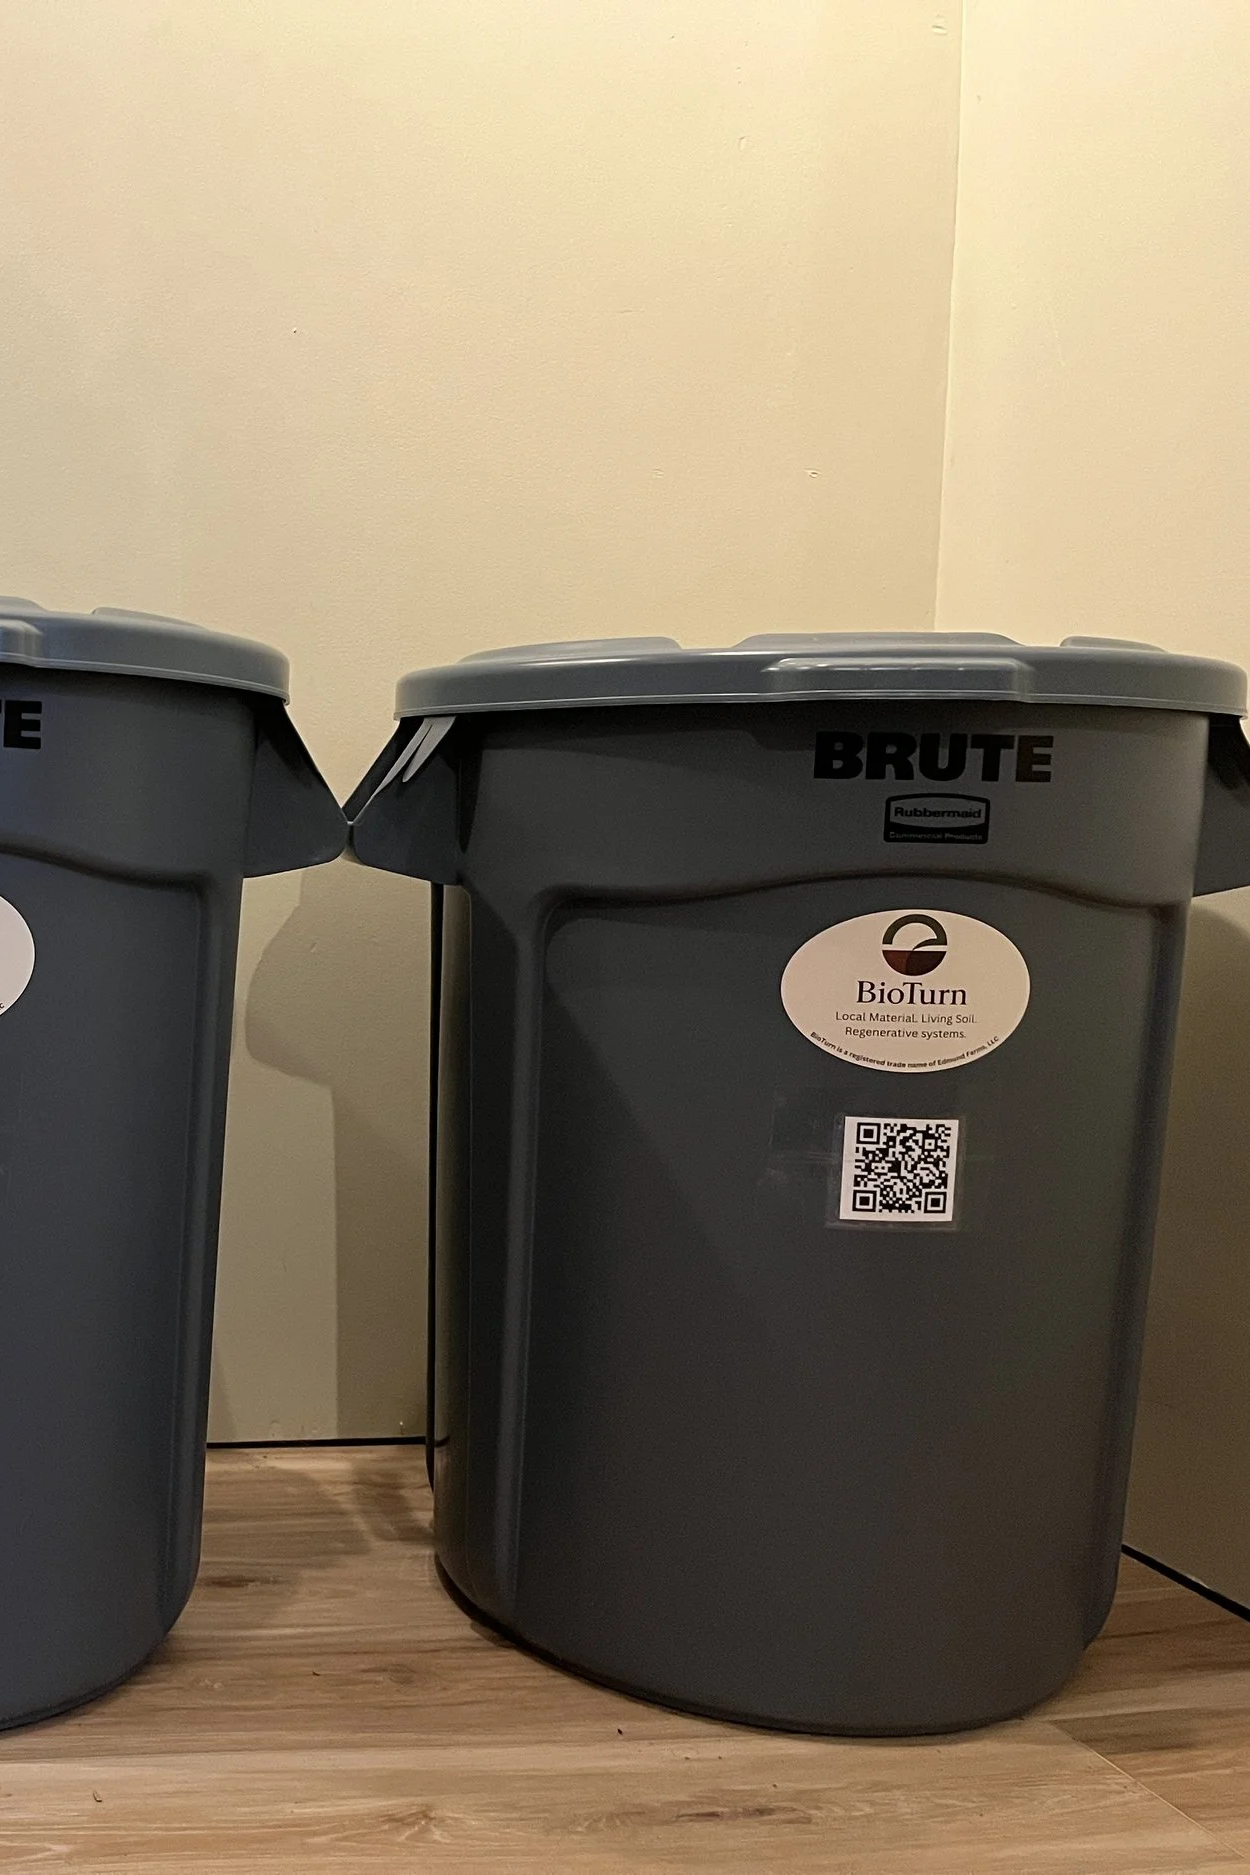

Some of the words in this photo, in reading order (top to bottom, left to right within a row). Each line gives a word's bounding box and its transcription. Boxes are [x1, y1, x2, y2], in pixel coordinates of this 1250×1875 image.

[814, 731, 1054, 782] BRUTE
[894, 807, 982, 818] Rubbermaid
[857, 980, 967, 1006] BioTurn
[836, 1011, 865, 1021] Local
[870, 1012, 918, 1023] Material.
[922, 1014, 952, 1025] Living
[956, 1014, 977, 1023] Soil.
[845, 1026, 918, 1038] Regenerative
[921, 1030, 966, 1040] systems.
[810, 1032, 836, 1050] BioTurn
[849, 1052, 885, 1066] registered
[938, 1054, 965, 1065] Edmund
[987, 1036, 999, 1046] LLC
